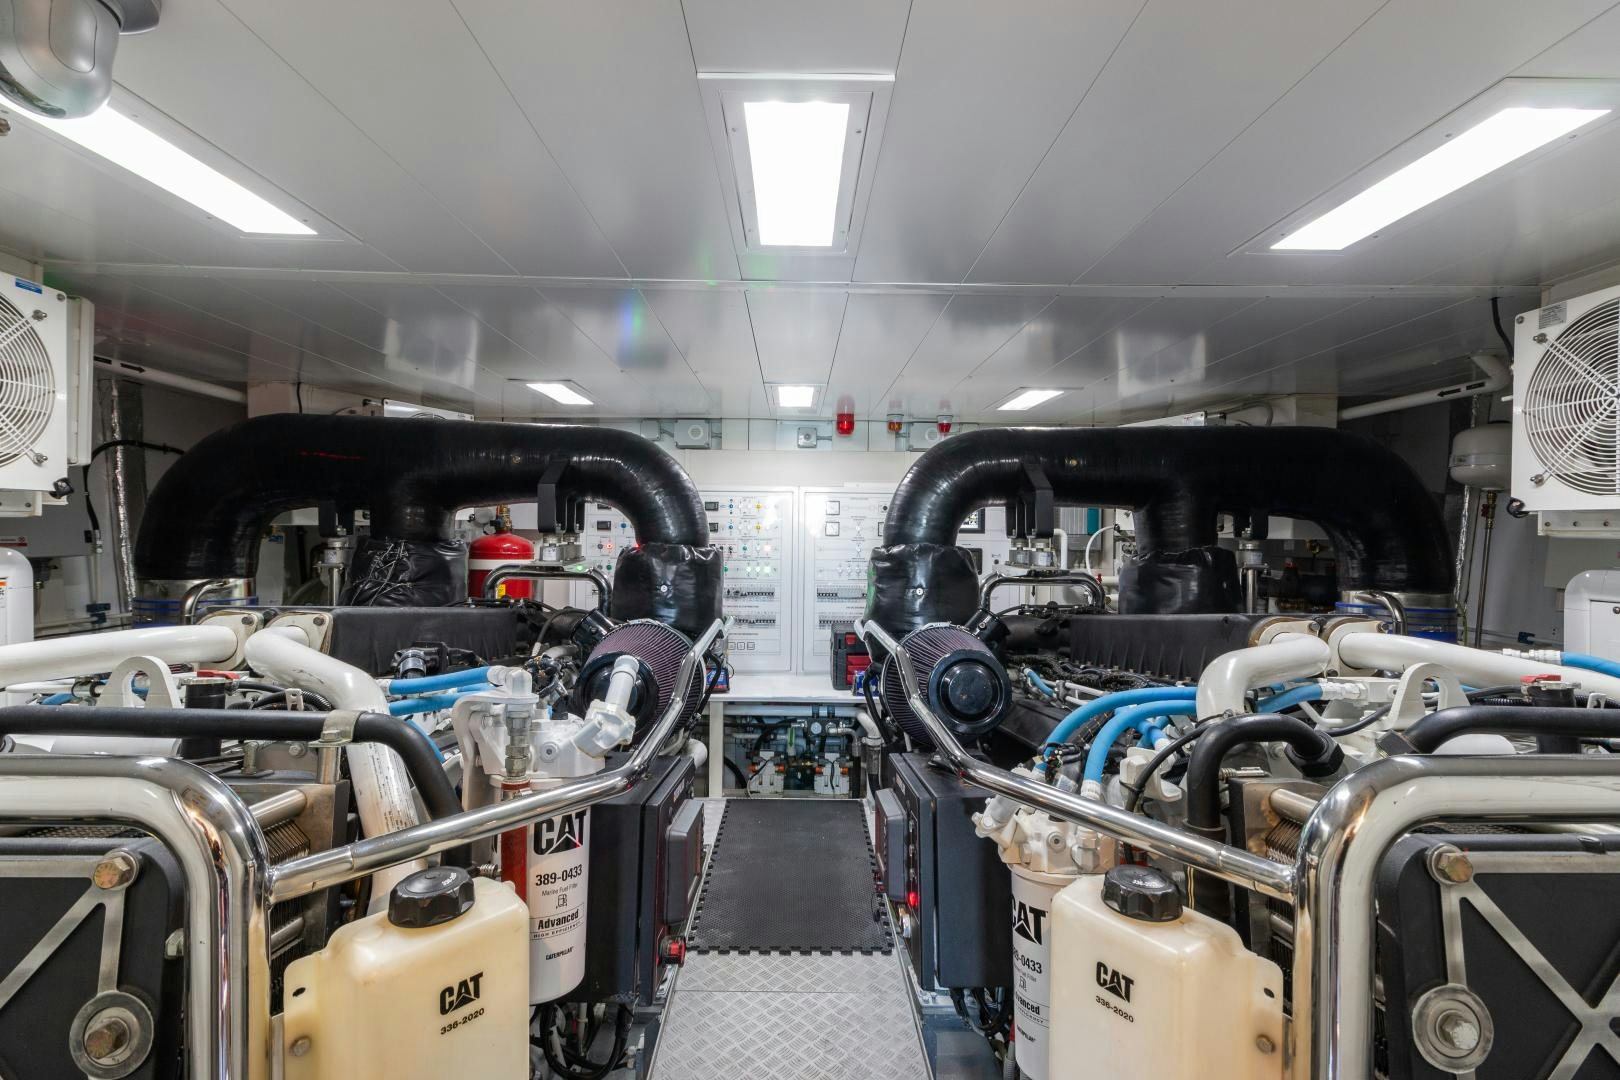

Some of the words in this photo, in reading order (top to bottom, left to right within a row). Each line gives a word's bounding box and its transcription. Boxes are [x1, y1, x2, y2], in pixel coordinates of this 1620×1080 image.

[533, 808, 588, 856] CAT
[534, 864, 583, 887] 389-0433
[538, 908, 579, 930] Advanced
[545, 946, 573, 961] CATERPILLAR
[1012, 945, 1042, 975] 9-0433
[439, 971, 484, 1016] CAT
[1095, 961, 1134, 1003] CAT
[1015, 991, 1041, 1016] vanced
[1095, 995, 1135, 1023] 336-2020
[440, 1007, 486, 1036] 336-2020
